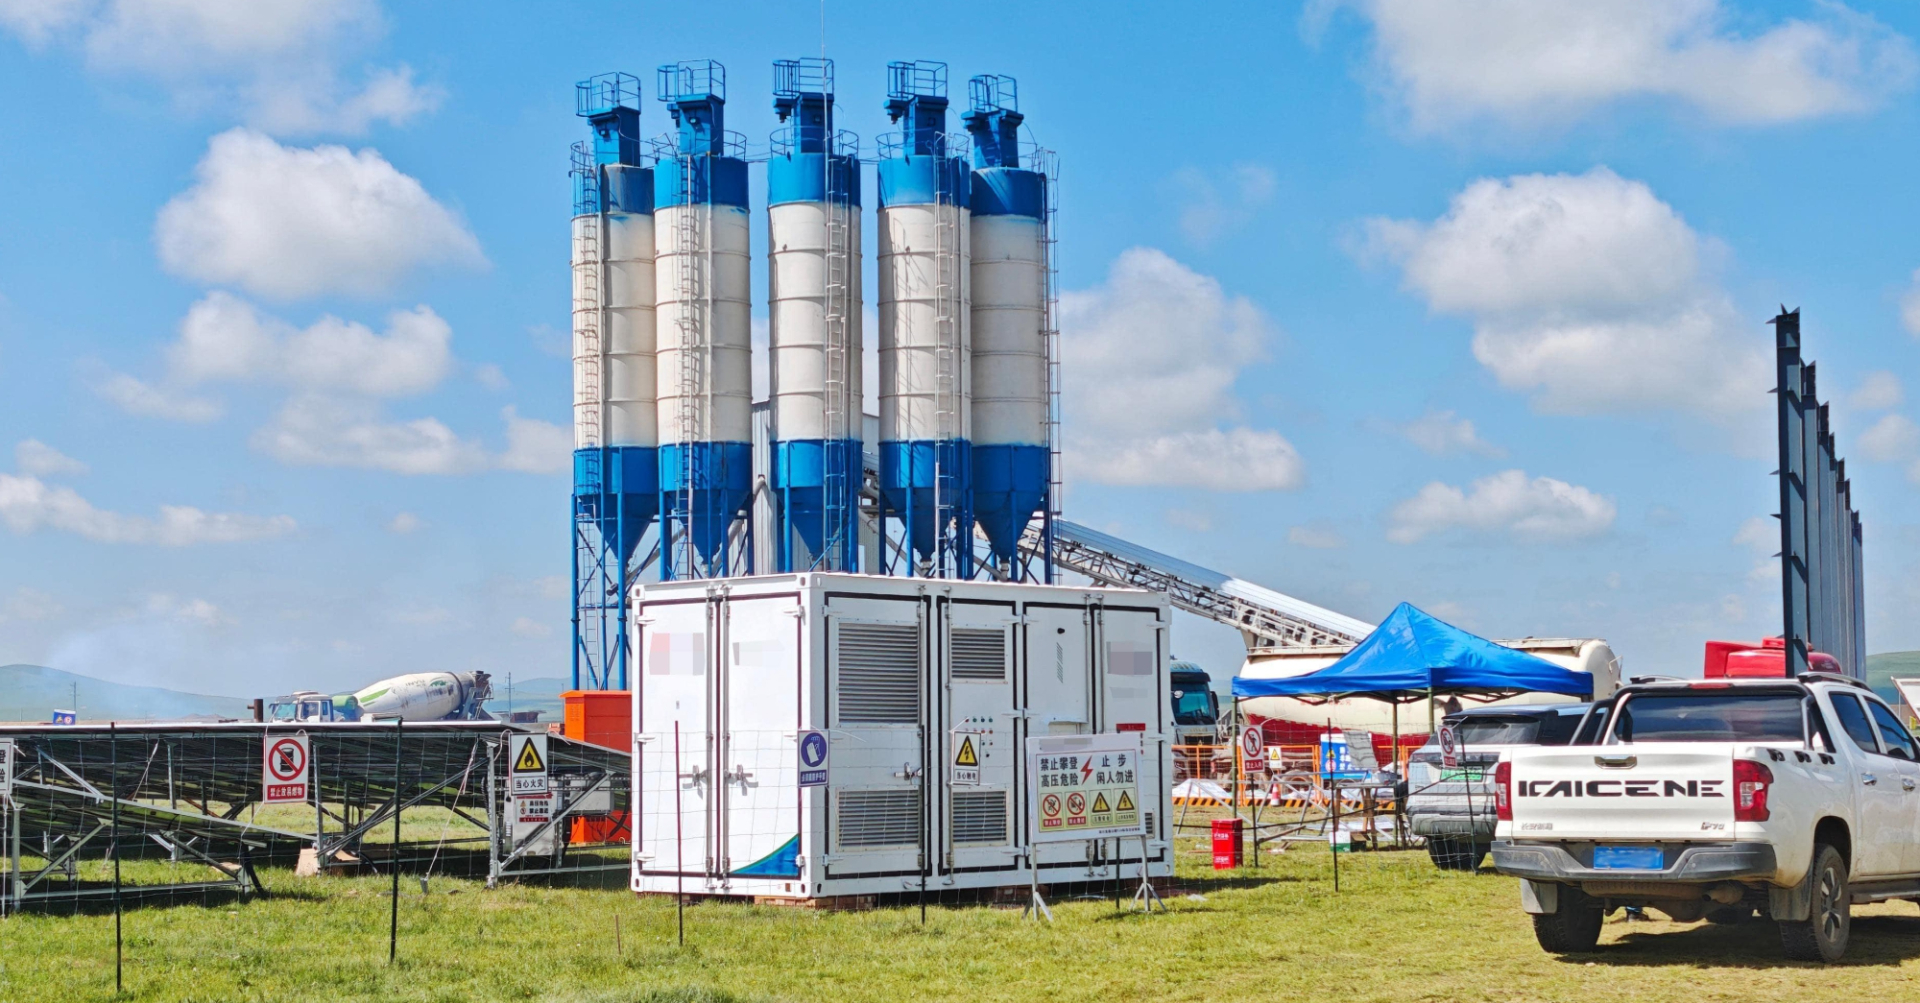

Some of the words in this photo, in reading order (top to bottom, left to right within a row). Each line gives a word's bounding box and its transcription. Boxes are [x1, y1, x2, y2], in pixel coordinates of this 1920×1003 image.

[1040, 756, 1078, 771] 禁止攀登
[515, 778, 544, 788] 当心火灾
[1041, 772, 1079, 787] 高压危险
[1096, 769, 1134, 785] 闲人勿进
